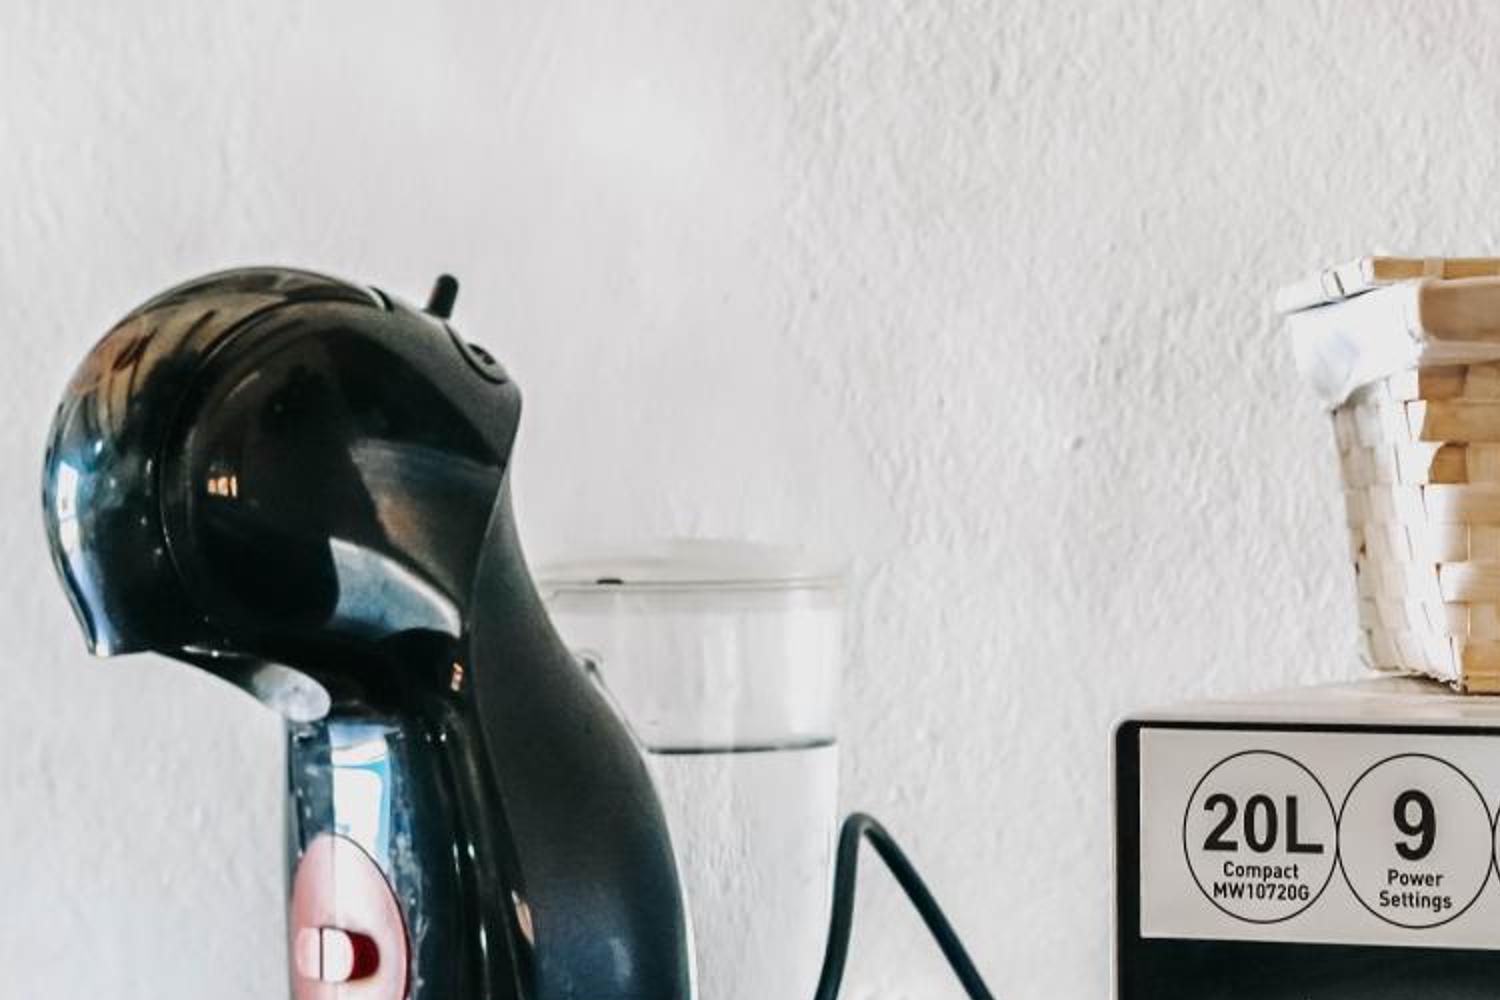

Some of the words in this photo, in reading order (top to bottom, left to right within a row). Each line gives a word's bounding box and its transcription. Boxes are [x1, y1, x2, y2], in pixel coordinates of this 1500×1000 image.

[1202, 793, 1324, 854] 20L
[1393, 789, 1436, 861] 9
[1223, 861, 1299, 884] Compact
[1387, 869, 1443, 887] Power
[1213, 883, 1310, 901] MW10720G
[1379, 890, 1453, 913] Settings
